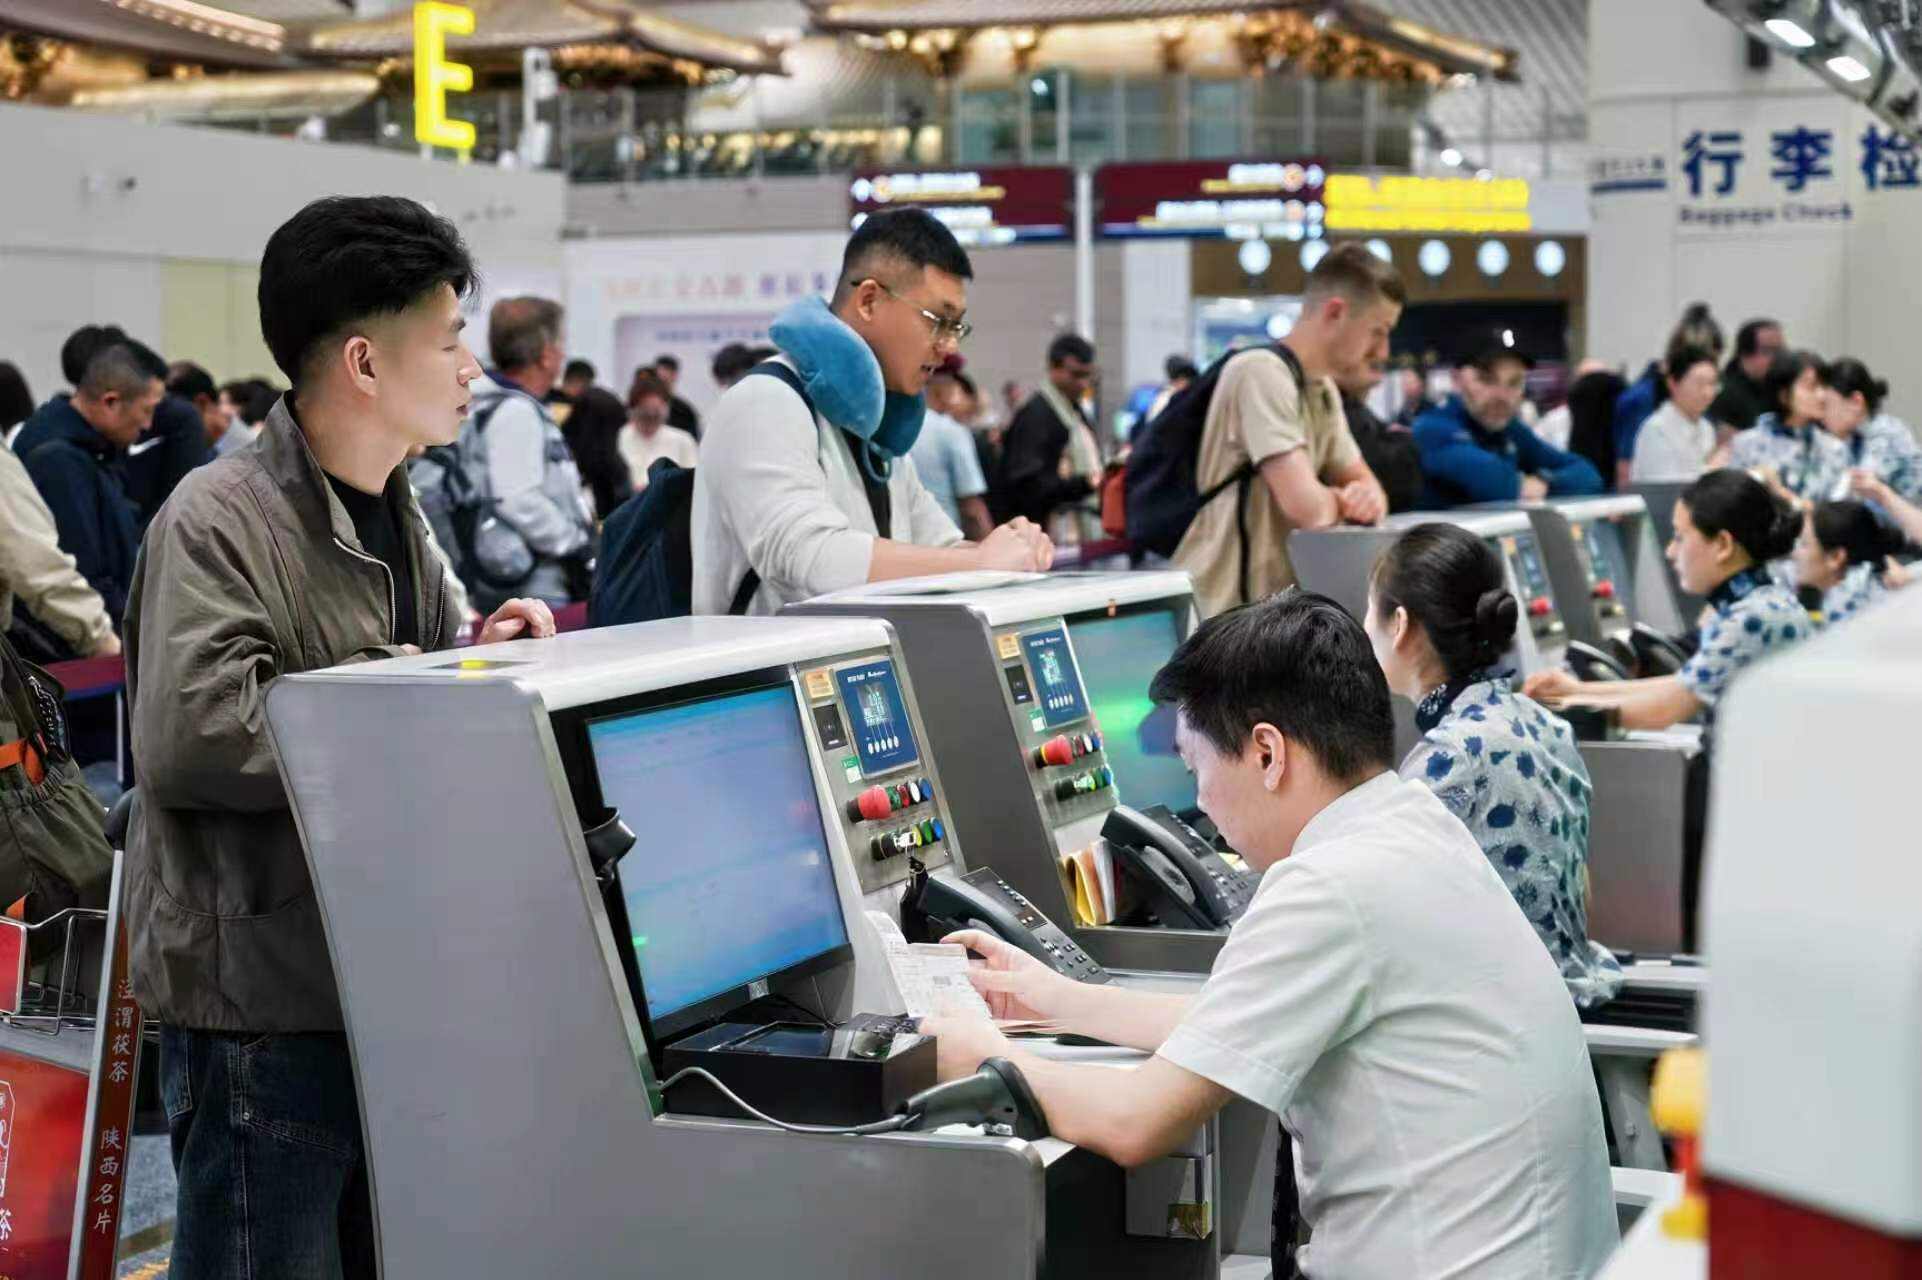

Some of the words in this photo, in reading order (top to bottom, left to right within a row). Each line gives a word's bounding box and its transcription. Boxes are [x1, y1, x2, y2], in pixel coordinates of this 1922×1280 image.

[413, 1, 476, 149] E
[1682, 123, 1921, 196] 行李检
[94, 1125, 122, 1234] 陕西名片
